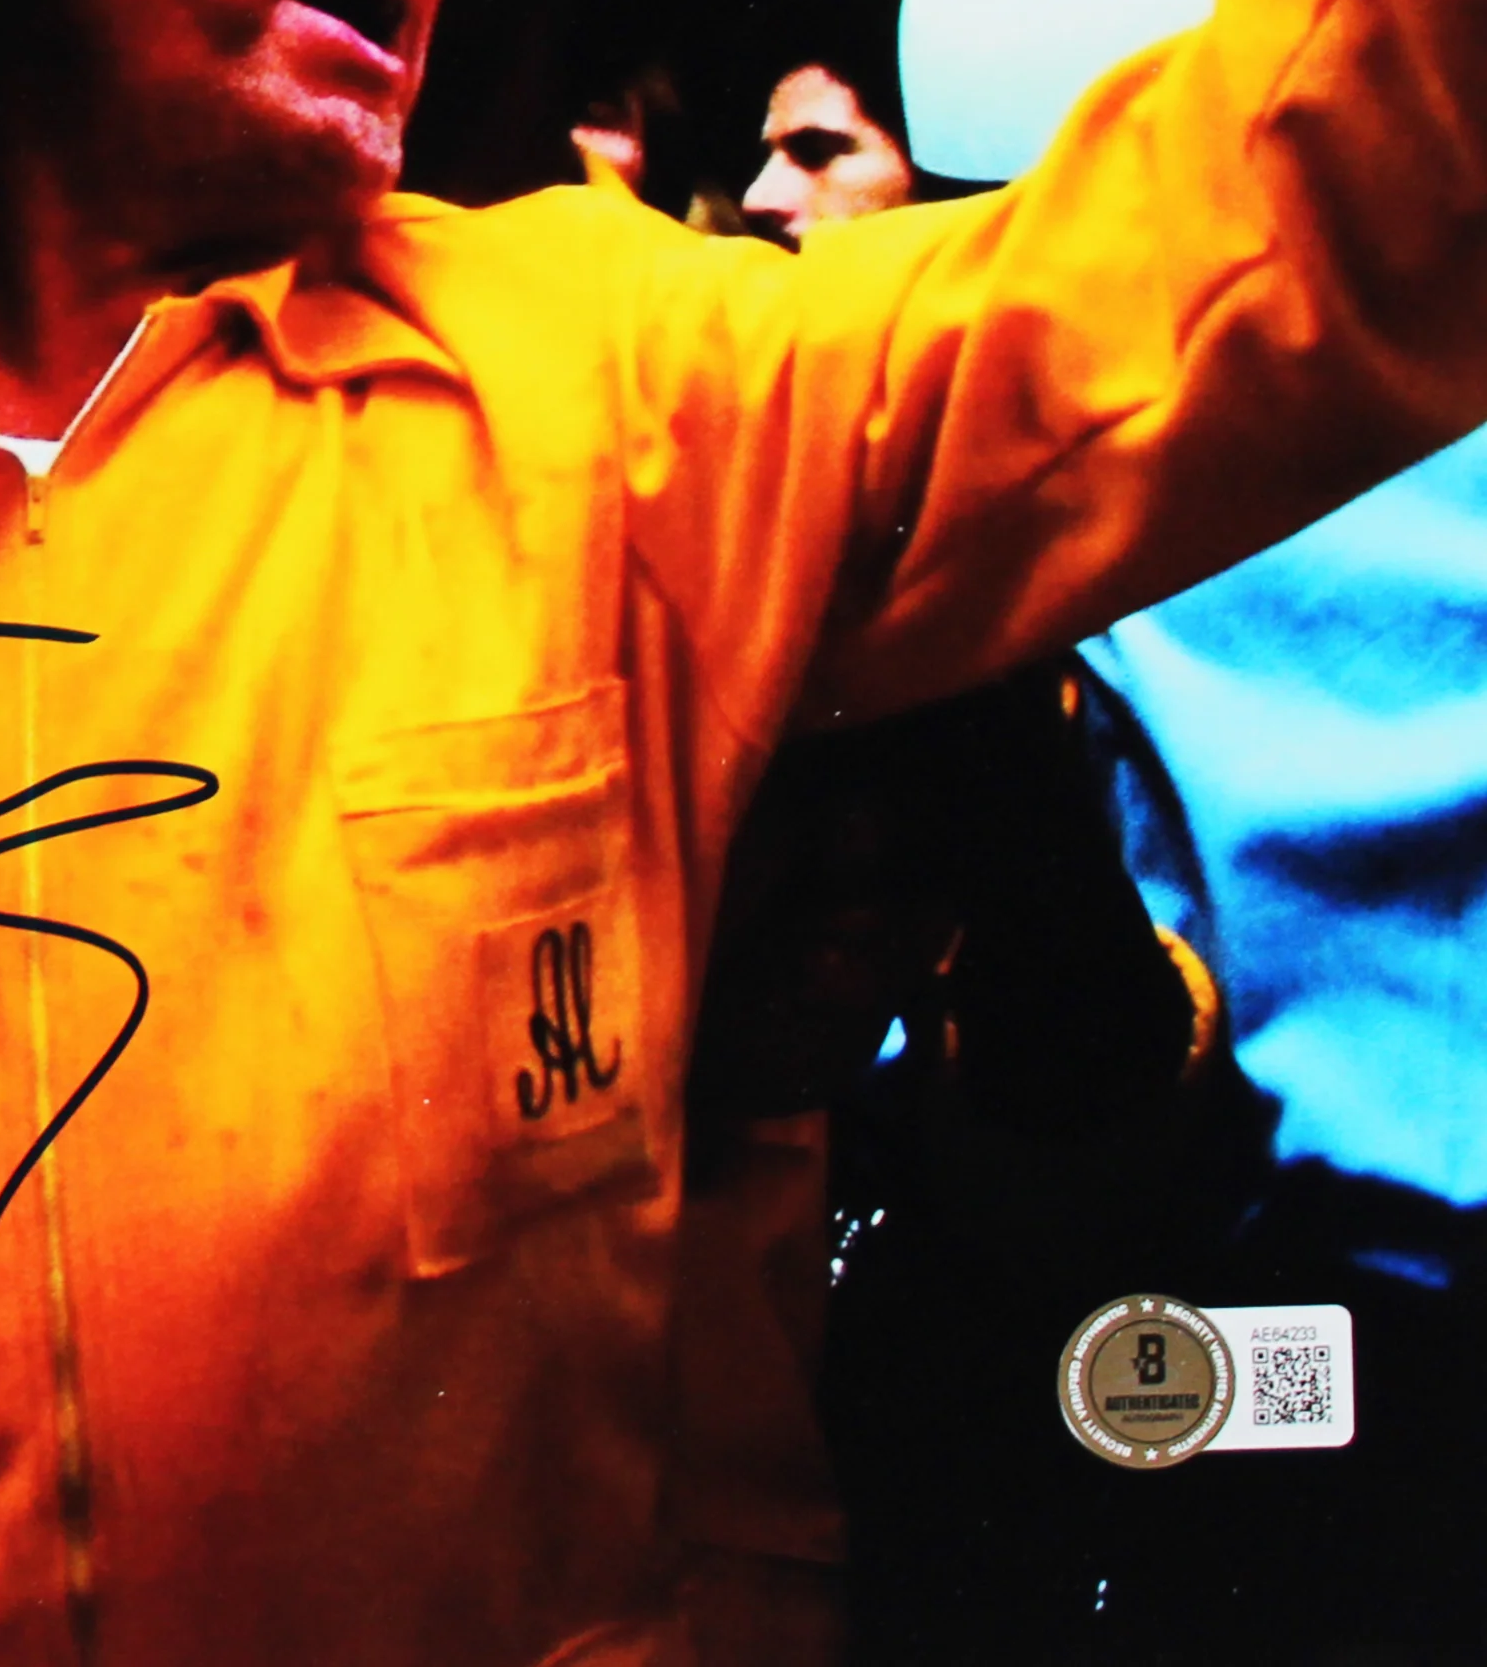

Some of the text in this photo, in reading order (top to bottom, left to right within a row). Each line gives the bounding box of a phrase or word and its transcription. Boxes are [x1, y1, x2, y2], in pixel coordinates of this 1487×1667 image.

[1068, 1303, 1132, 1458] BECKETT VERIFIED AUTHENTIC
[1163, 1302, 1228, 1457] BECKETT VERIFIED AUTHENTIC
